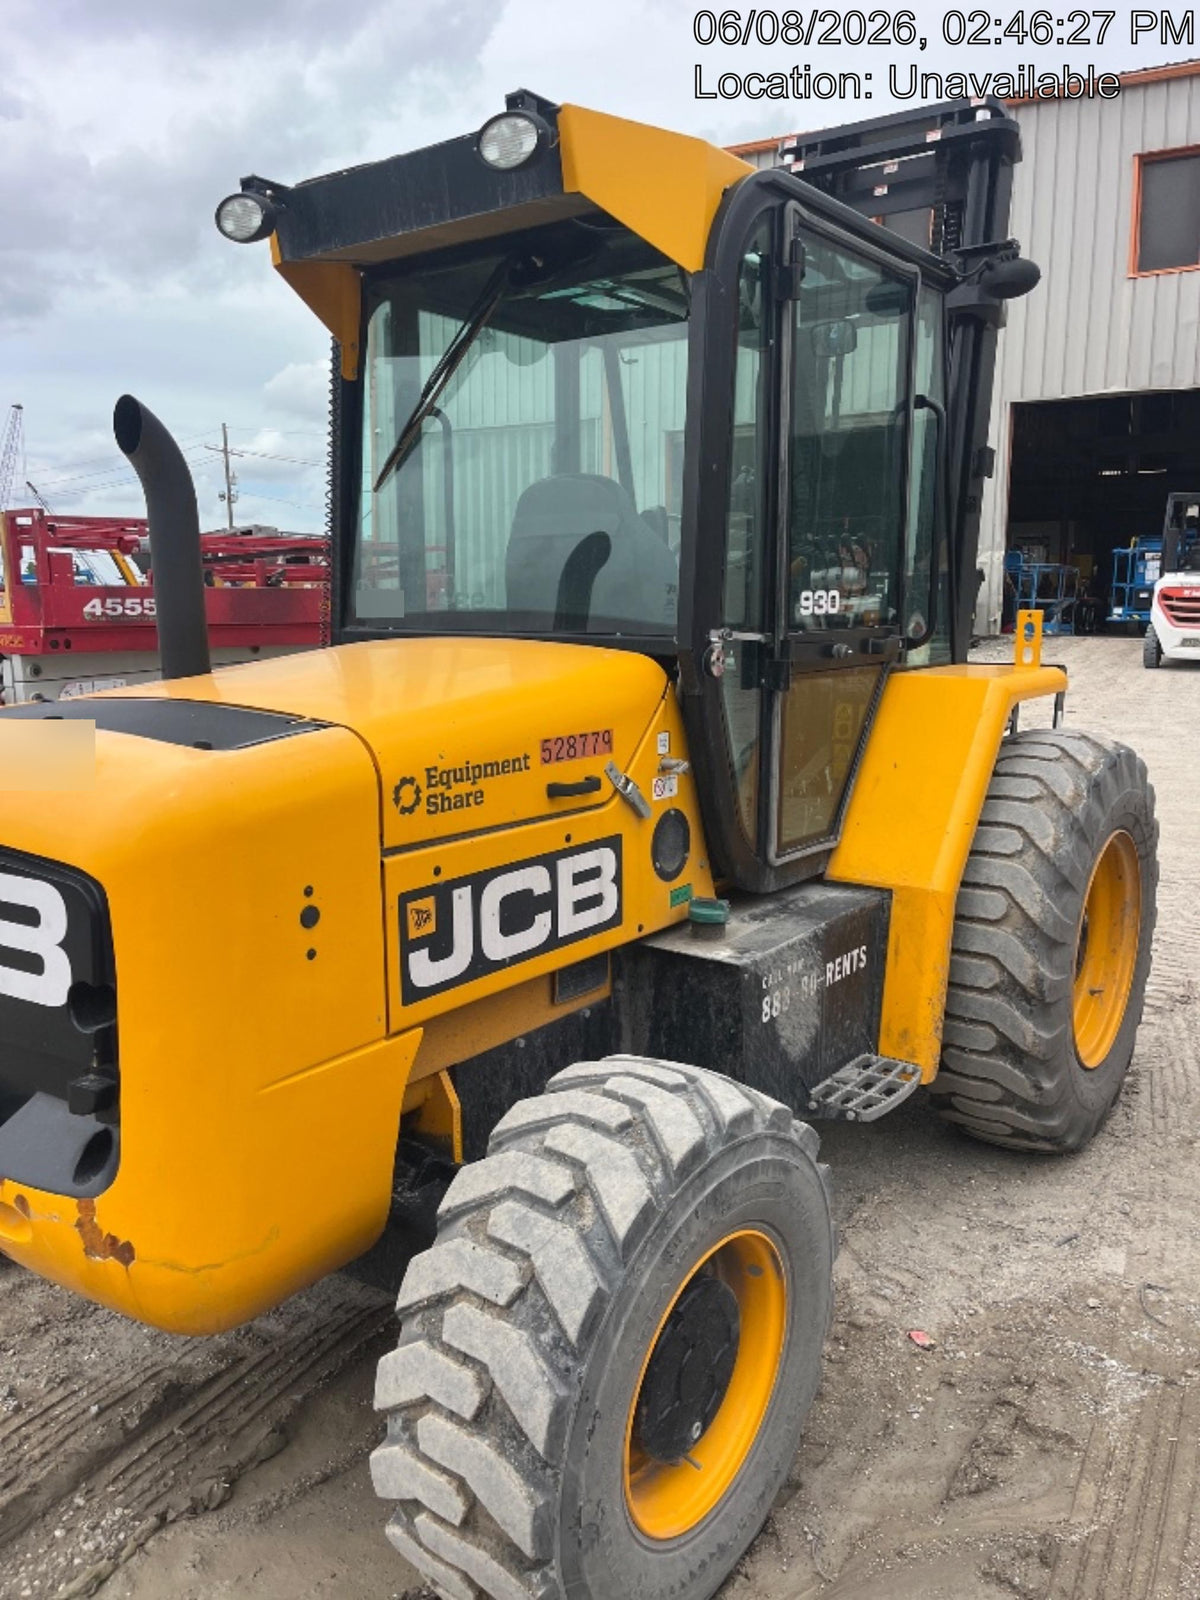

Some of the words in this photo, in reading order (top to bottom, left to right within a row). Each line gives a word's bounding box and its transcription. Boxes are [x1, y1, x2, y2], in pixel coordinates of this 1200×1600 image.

[800, 589, 840, 615] 930
[542, 730, 612, 763] 528779
[425, 753, 531, 790] Equipment
[426, 789, 484, 816] Share
[408, 847, 619, 988] JCB
